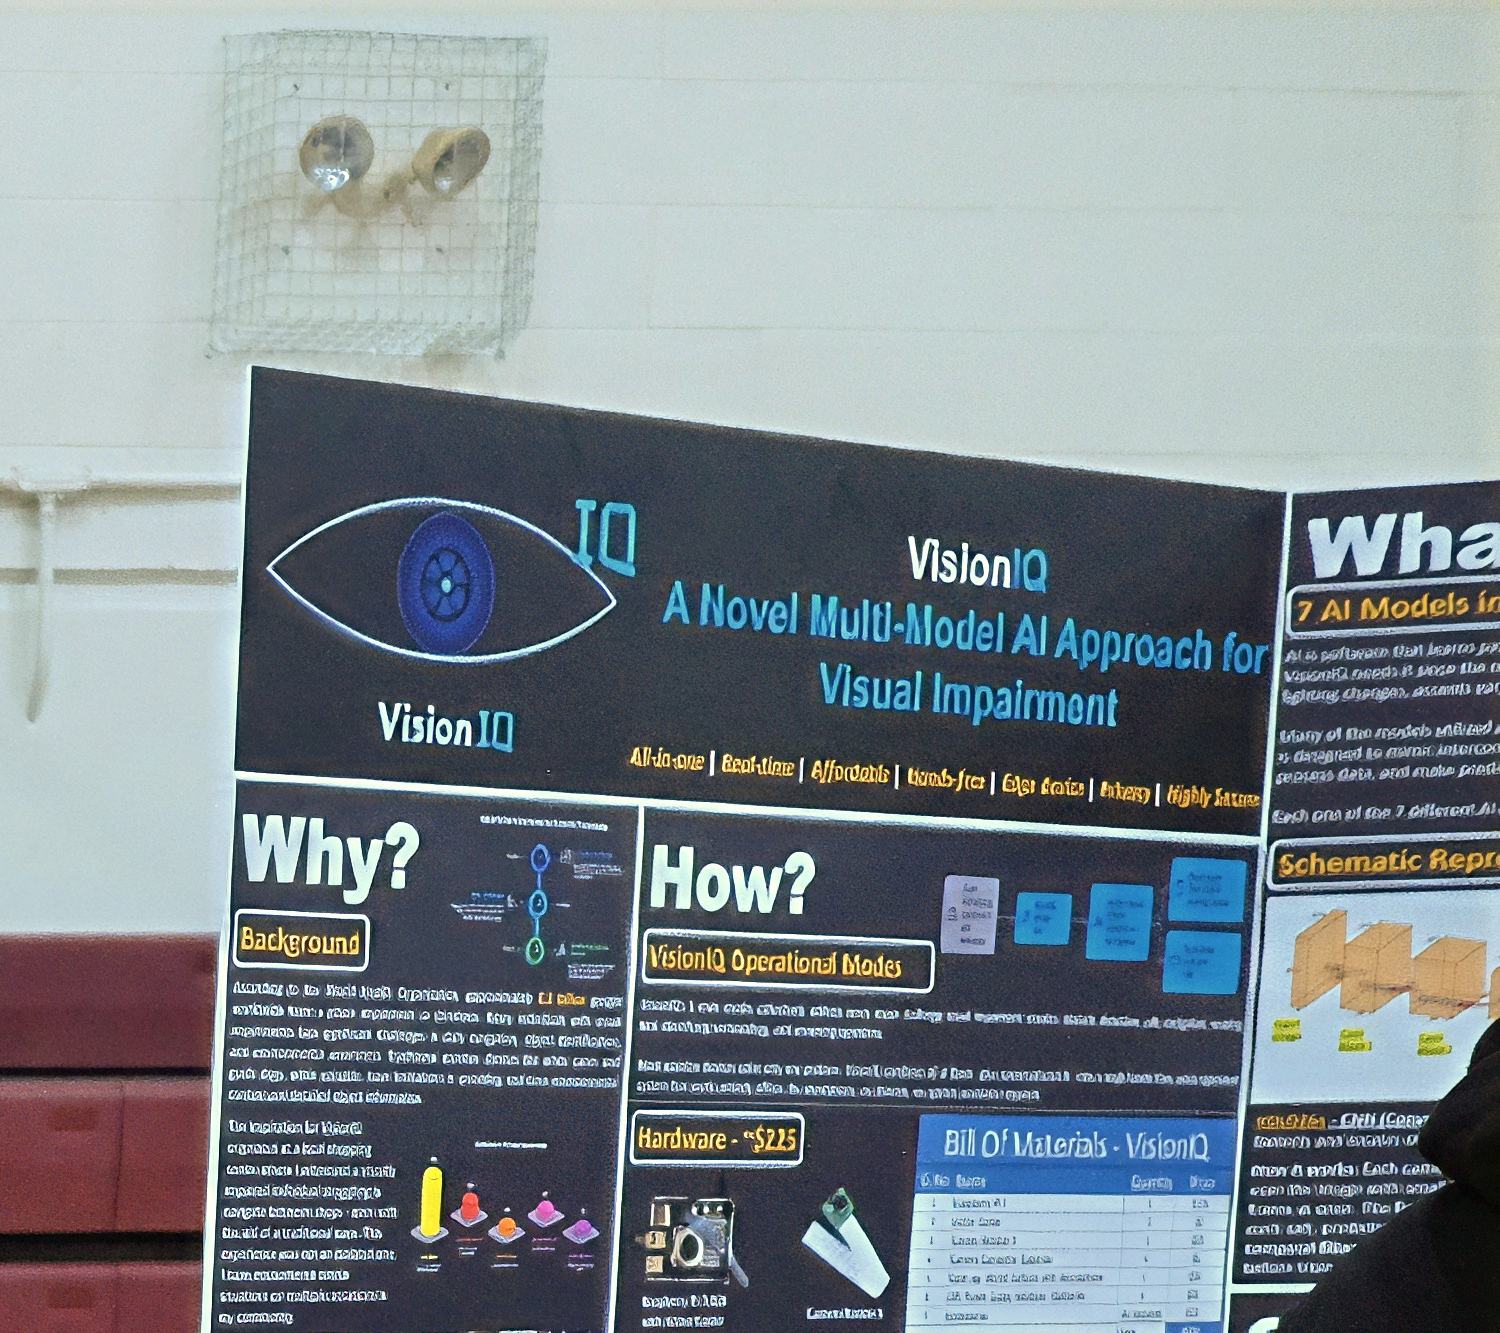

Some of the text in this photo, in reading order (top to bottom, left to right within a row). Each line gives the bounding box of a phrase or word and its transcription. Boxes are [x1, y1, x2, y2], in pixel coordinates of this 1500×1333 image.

[574, 498, 637, 577] IQ
[908, 535, 1049, 594] VisionIQ
[1307, 512, 1500, 579] Wha
[662, 580, 1270, 675] A Novel Multi-Model AI Approach for
[1298, 600, 1313, 622] 7
[1320, 598, 1350, 622] AI
[1359, 592, 1469, 620] Models
[819, 664, 1118, 727] Visual Impairment
[242, 813, 420, 906] Why?
[650, 844, 816, 915] How?
[1278, 849, 1422, 877] Schematic
[240, 926, 360, 957] Background
[638, 1129, 726, 1153] Hardware
